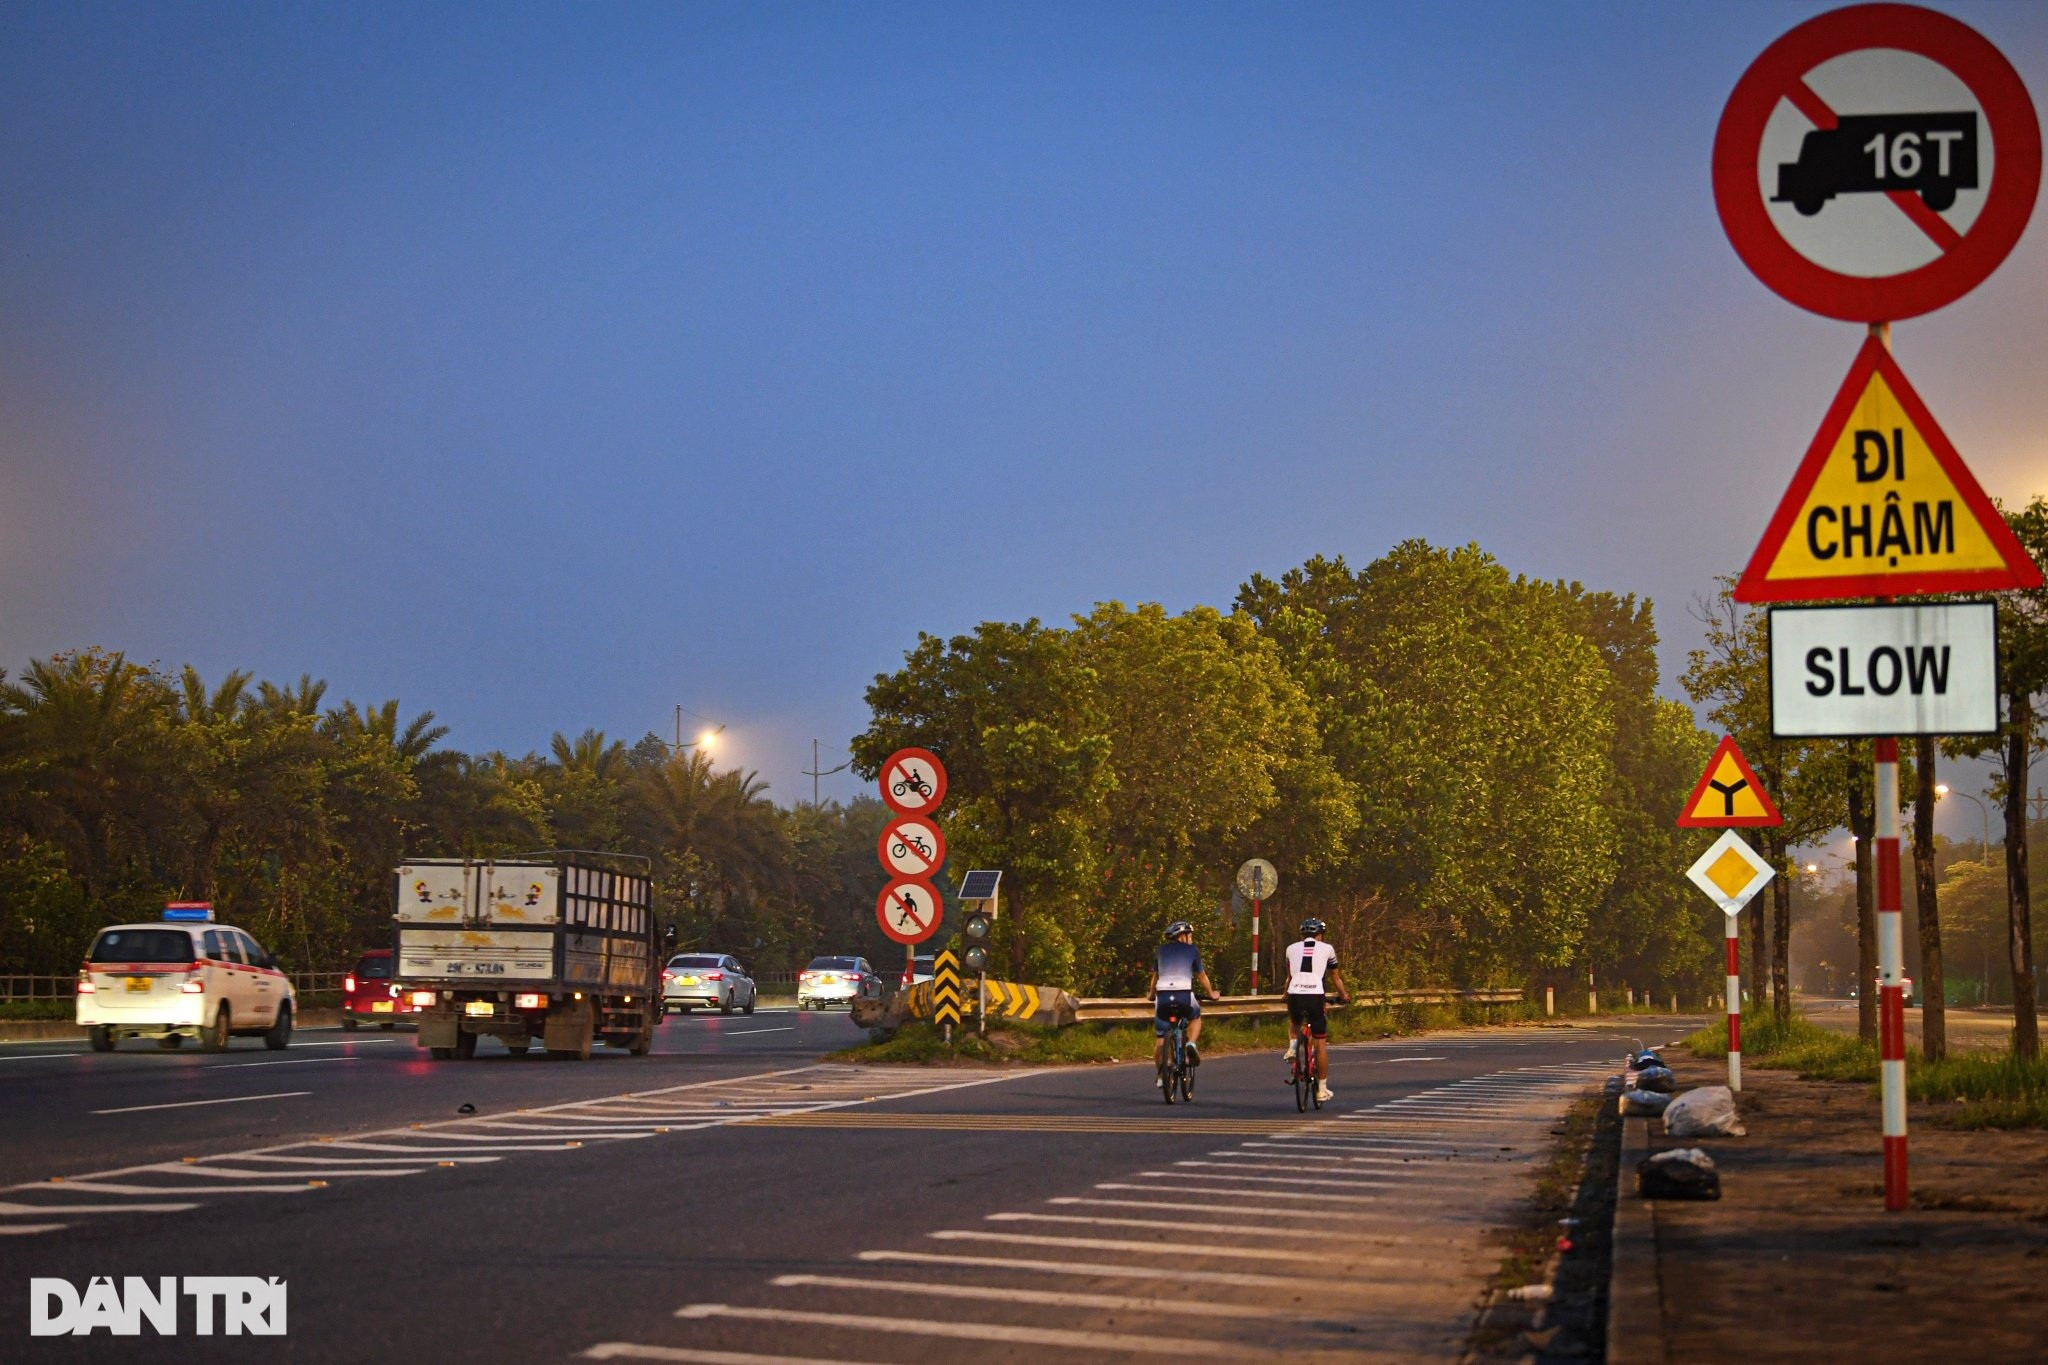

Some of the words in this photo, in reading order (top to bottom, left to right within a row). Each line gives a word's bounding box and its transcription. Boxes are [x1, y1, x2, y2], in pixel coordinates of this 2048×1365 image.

[1863, 130, 1963, 181] 16T
[1852, 427, 1904, 483] ĐI
[1807, 495, 1956, 567] CHẬM
[1805, 645, 1950, 699] SLOW
